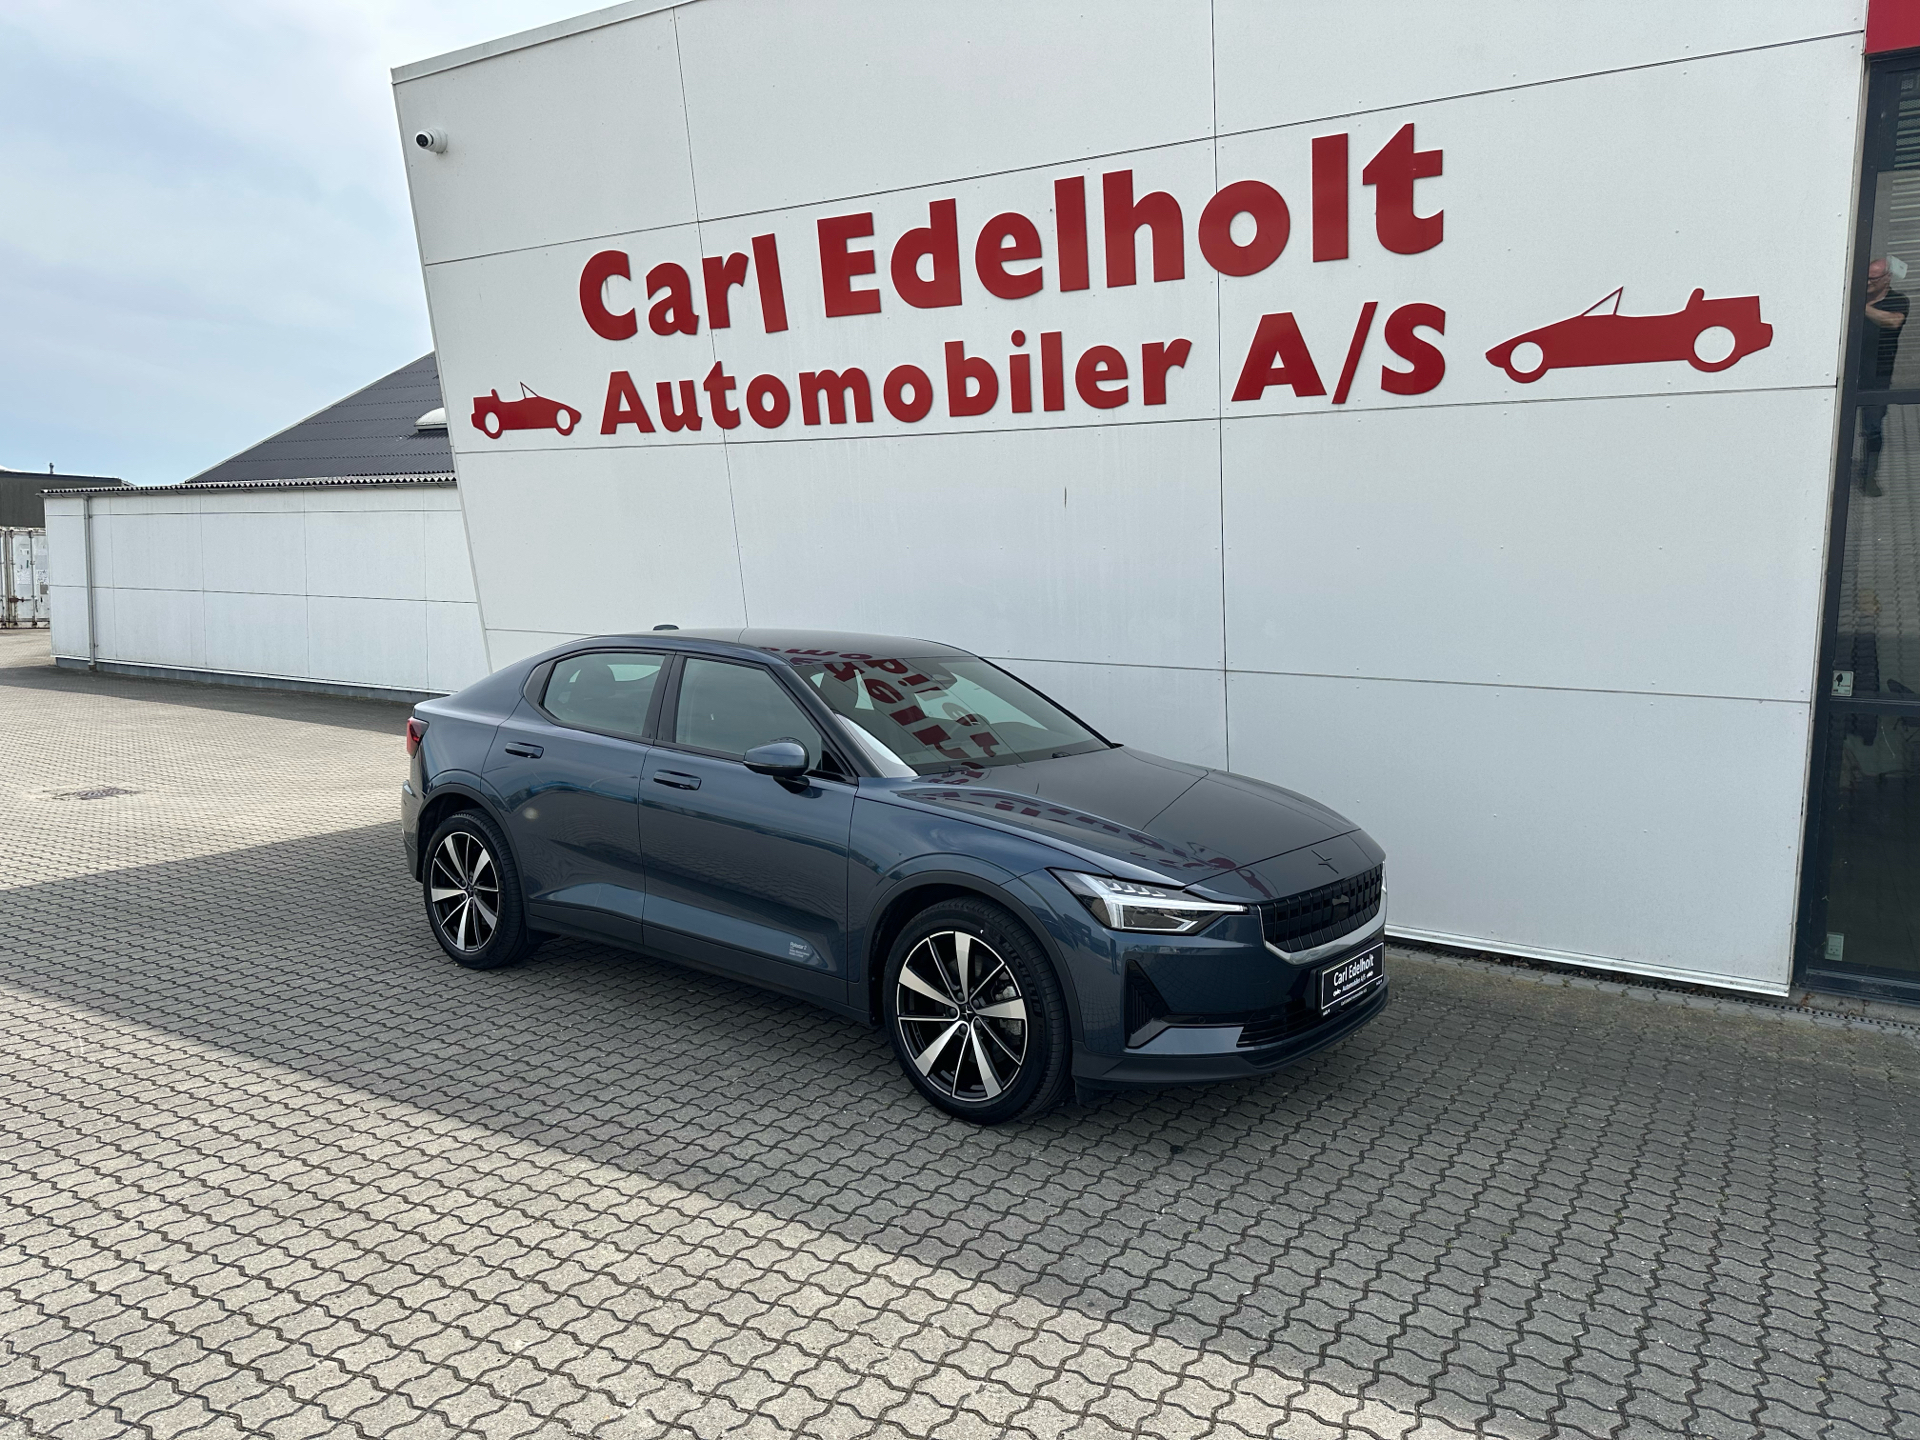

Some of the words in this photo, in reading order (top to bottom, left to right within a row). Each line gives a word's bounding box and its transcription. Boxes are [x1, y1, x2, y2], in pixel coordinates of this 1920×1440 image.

[579, 233, 788, 340] Carl
[817, 123, 1444, 317] Edelholt
[600, 329, 1193, 434] Automobiler
[1232, 301, 1446, 404] A/S
[1334, 966, 1348, 986] Carl
[1349, 954, 1374, 978] Edelholt
